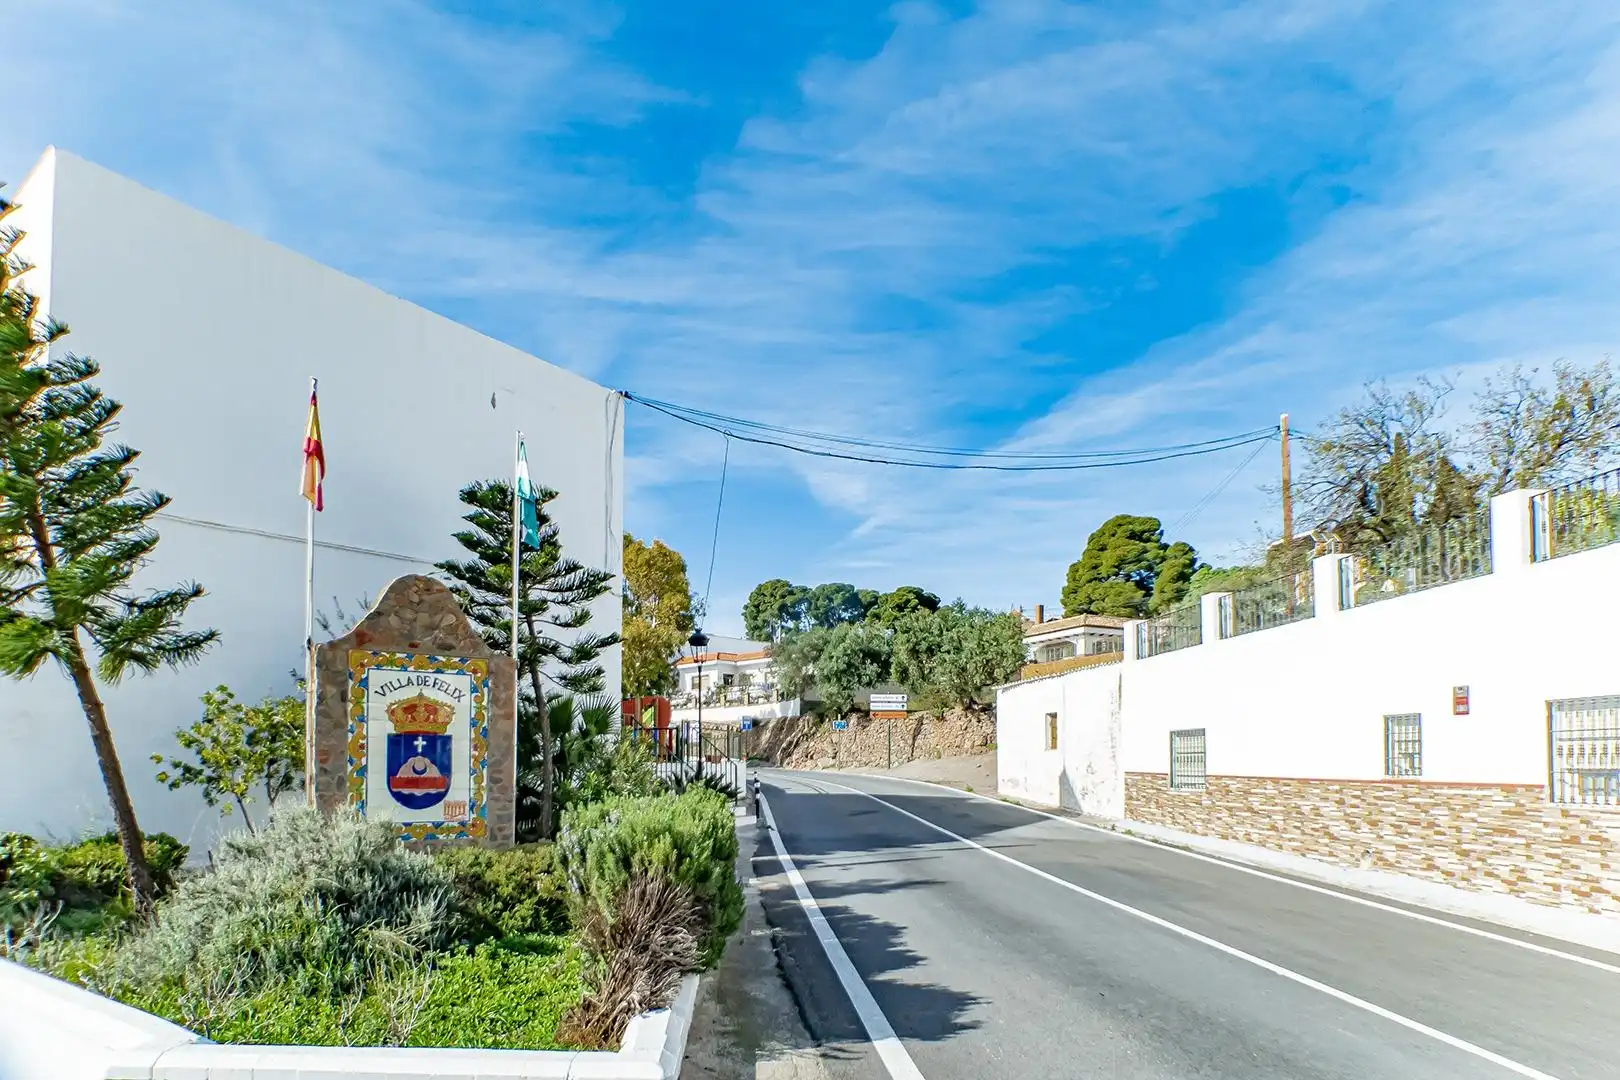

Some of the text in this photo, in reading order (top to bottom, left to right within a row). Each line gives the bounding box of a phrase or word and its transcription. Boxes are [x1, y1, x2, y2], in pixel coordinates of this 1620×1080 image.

[374, 675, 466, 703] VILLA DE FELIX
